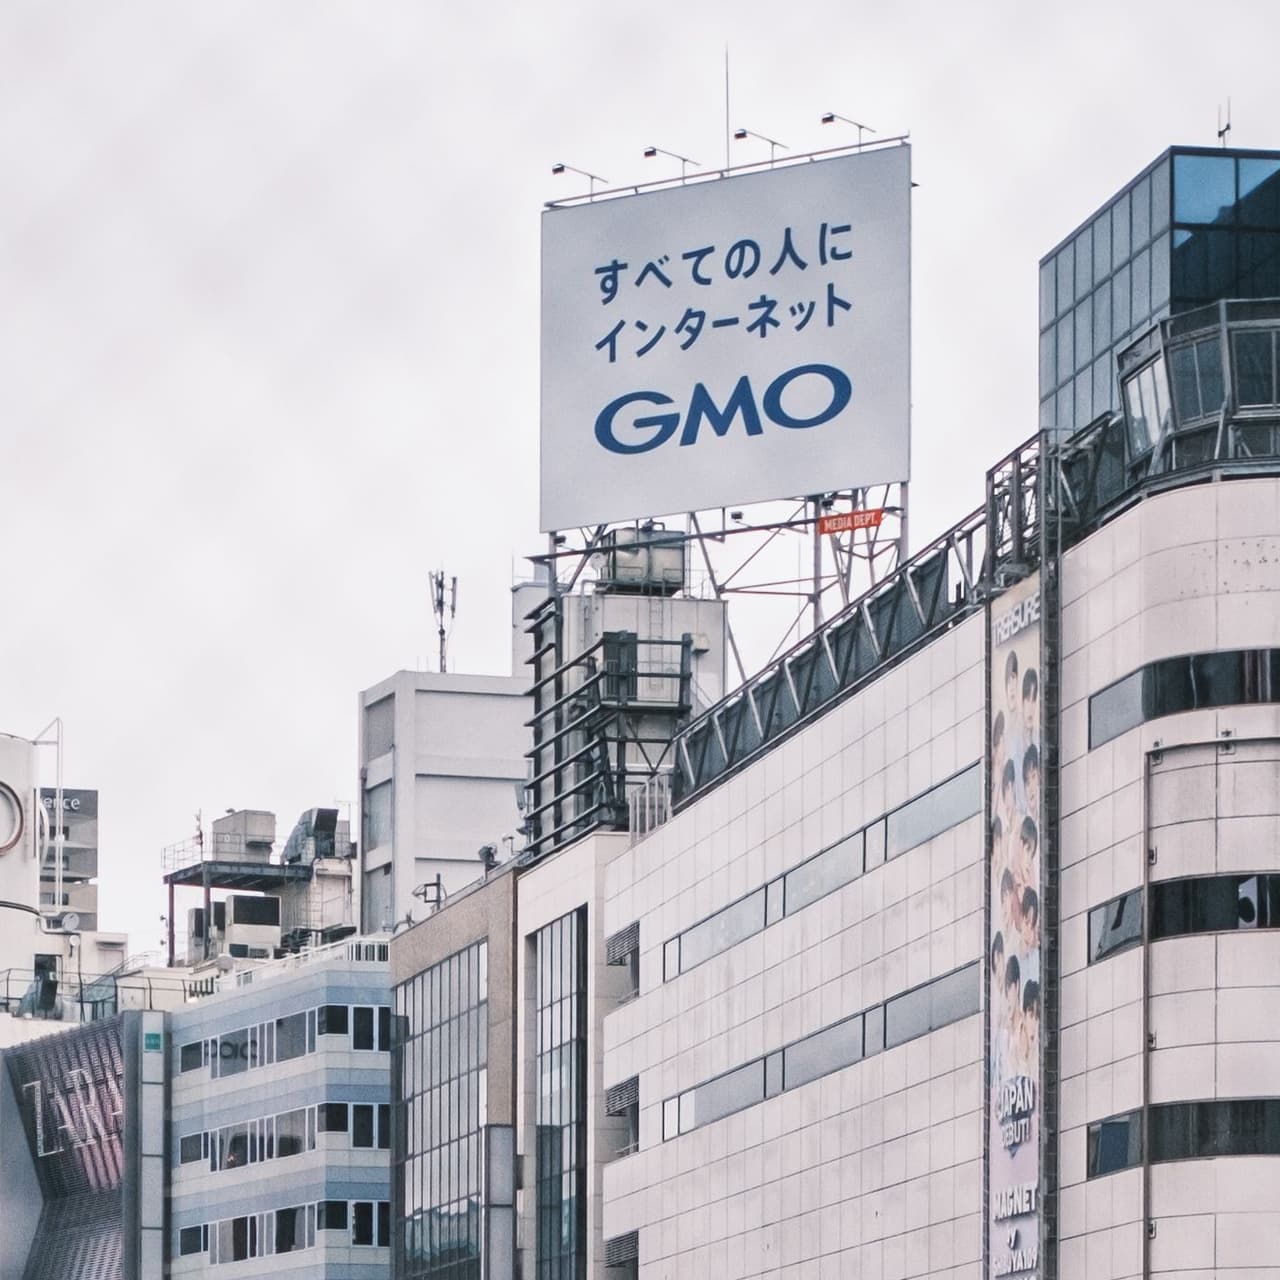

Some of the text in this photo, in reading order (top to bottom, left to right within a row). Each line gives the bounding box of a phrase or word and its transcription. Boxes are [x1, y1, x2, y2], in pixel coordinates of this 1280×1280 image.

[595, 223, 852, 305] すべての人に
[595, 283, 852, 363] インターネット
[594, 364, 852, 455] GMO
[824, 515, 852, 532] MEDIA
[991, 591, 1040, 648] TREASURE
[999, 1078, 1034, 1119] JAPAN
[993, 1184, 1038, 1222] MAGNET
